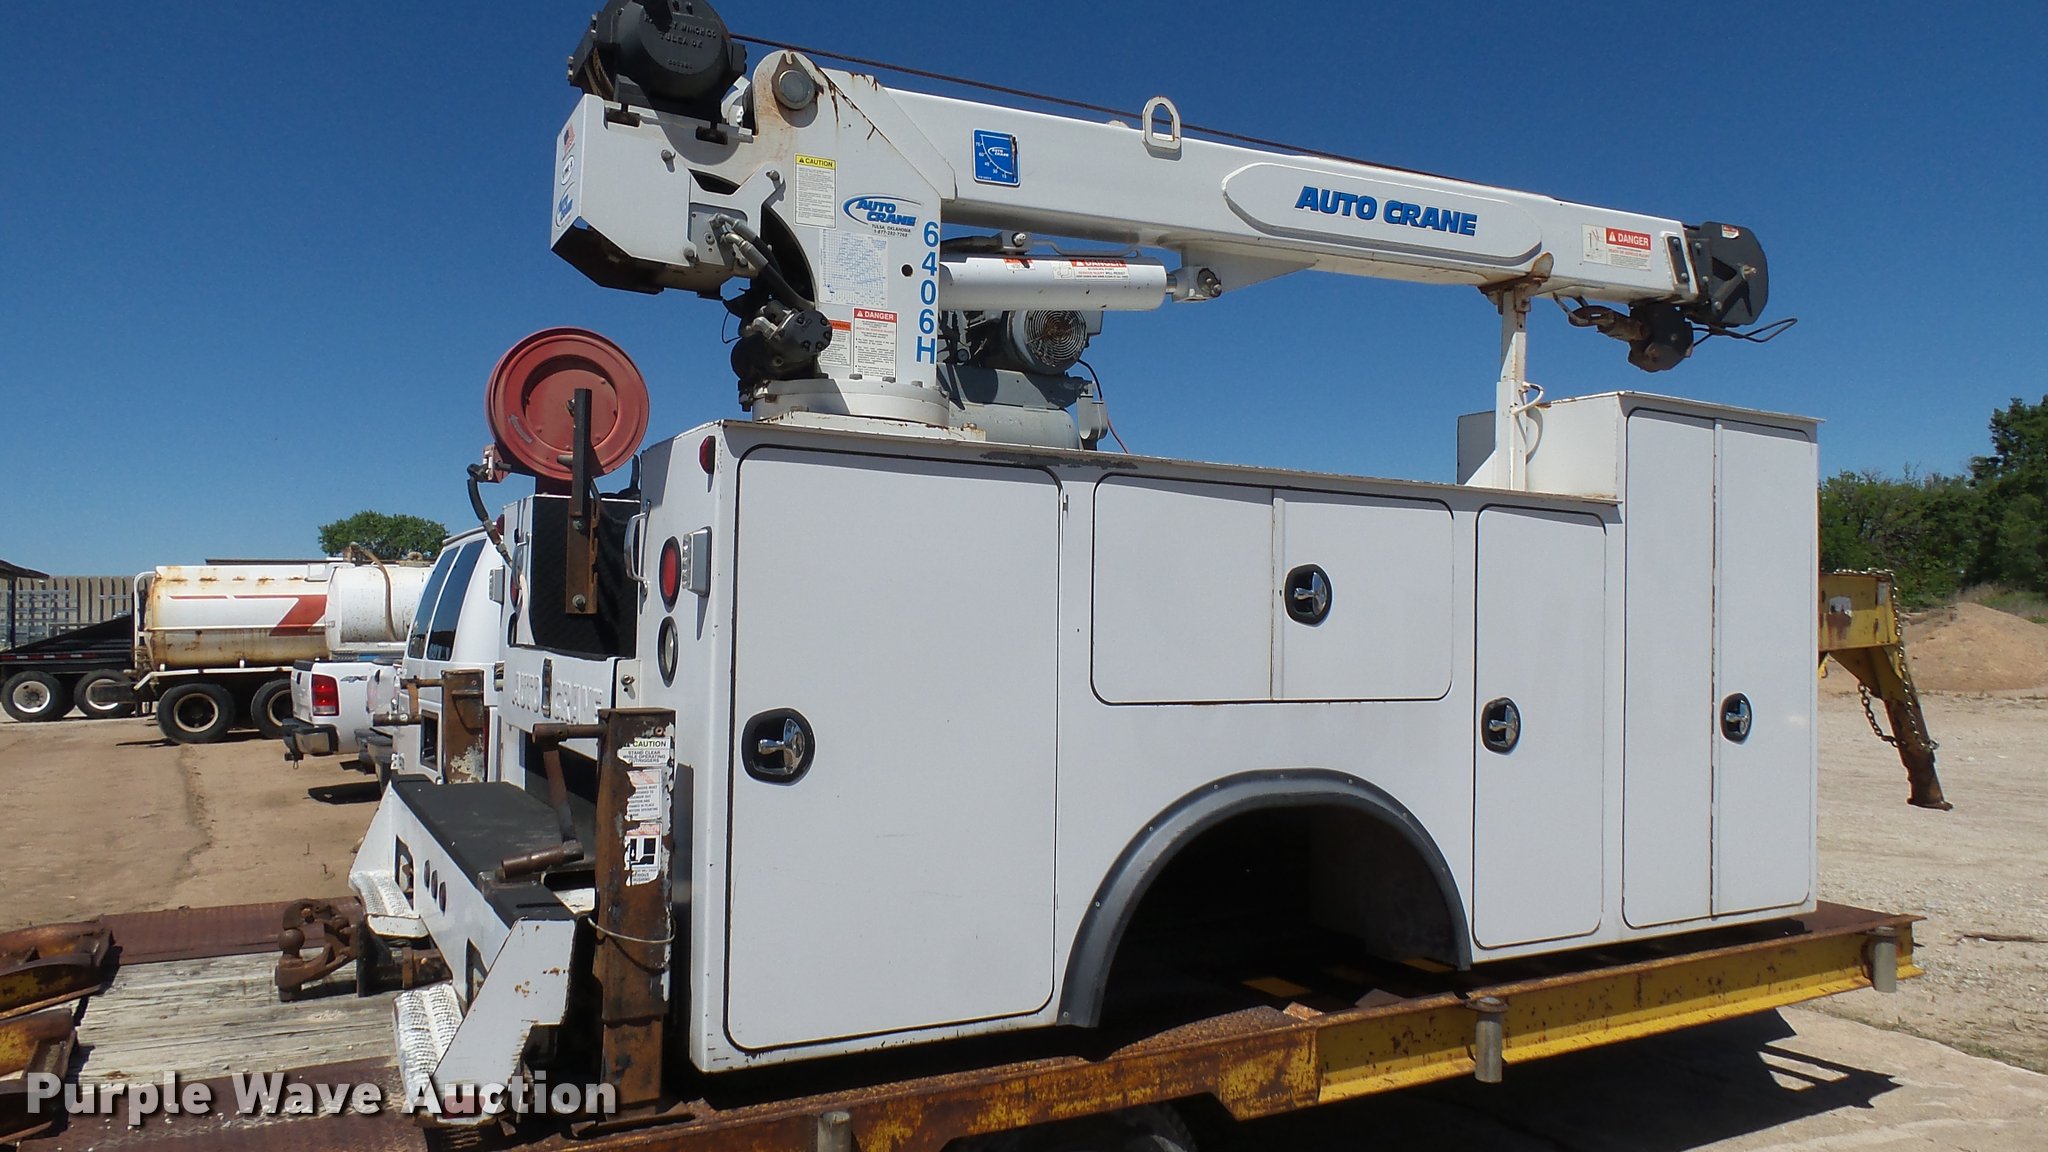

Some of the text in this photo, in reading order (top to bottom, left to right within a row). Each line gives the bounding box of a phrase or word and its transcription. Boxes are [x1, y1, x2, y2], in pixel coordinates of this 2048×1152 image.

[805, 157, 833, 168] CAUTION
[856, 199, 917, 227] AUTO CRANE
[1295, 186, 1477, 237] AUTO CRANE
[1617, 233, 1649, 247] DANGER
[864, 312, 894, 321] DANGER
[632, 740, 667, 748] CAUTION
